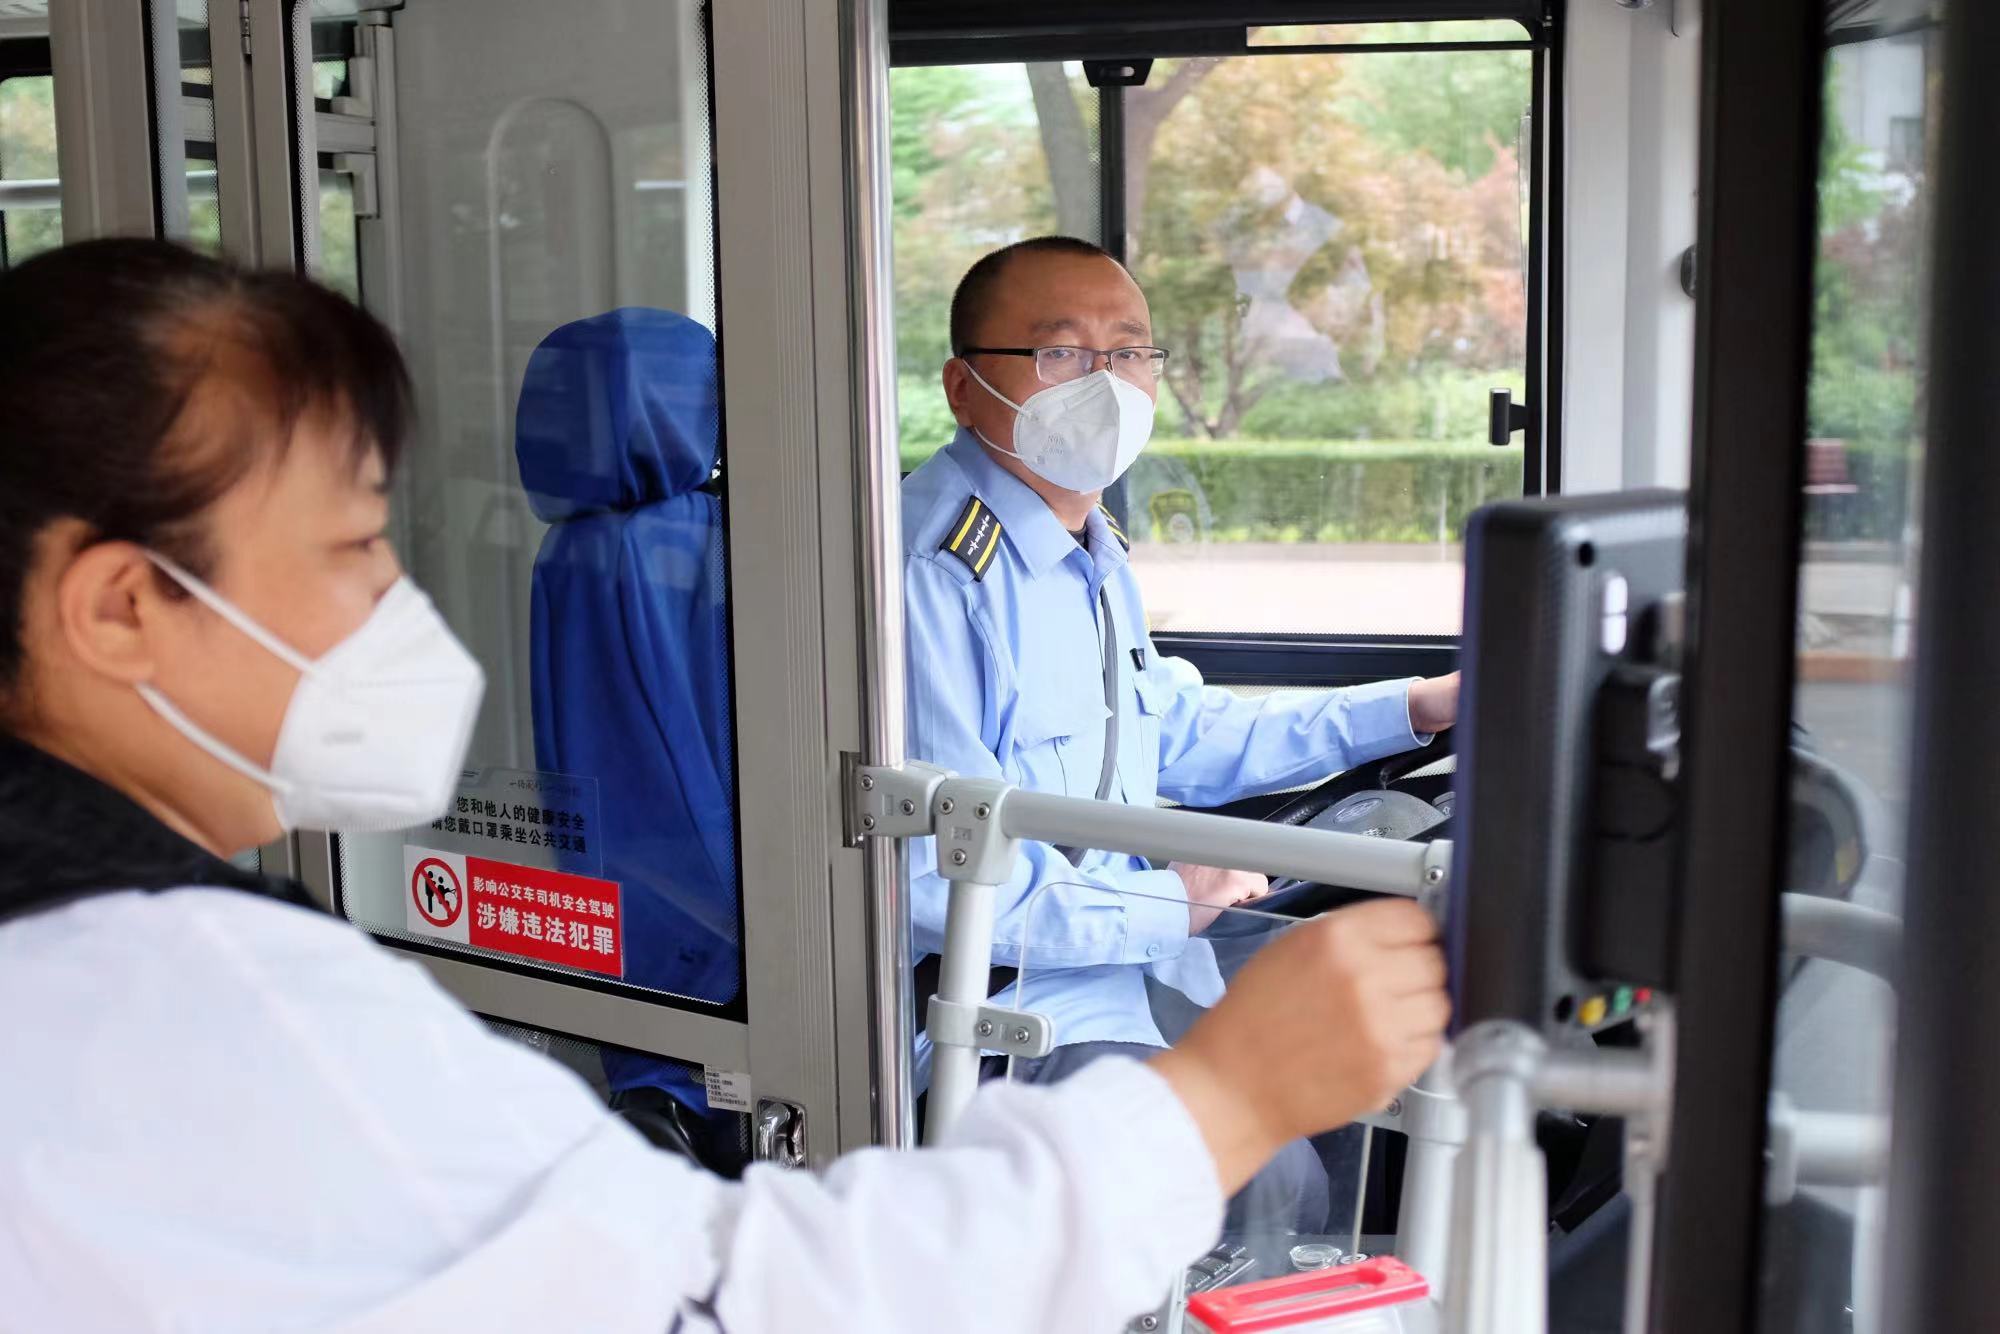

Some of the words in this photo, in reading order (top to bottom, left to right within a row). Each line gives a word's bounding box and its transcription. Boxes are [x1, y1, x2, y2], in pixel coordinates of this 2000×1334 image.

[473, 876, 615, 919] 影响公交车司机安全驾驶
[476, 902, 615, 956] 涉嫌违法犯罪
